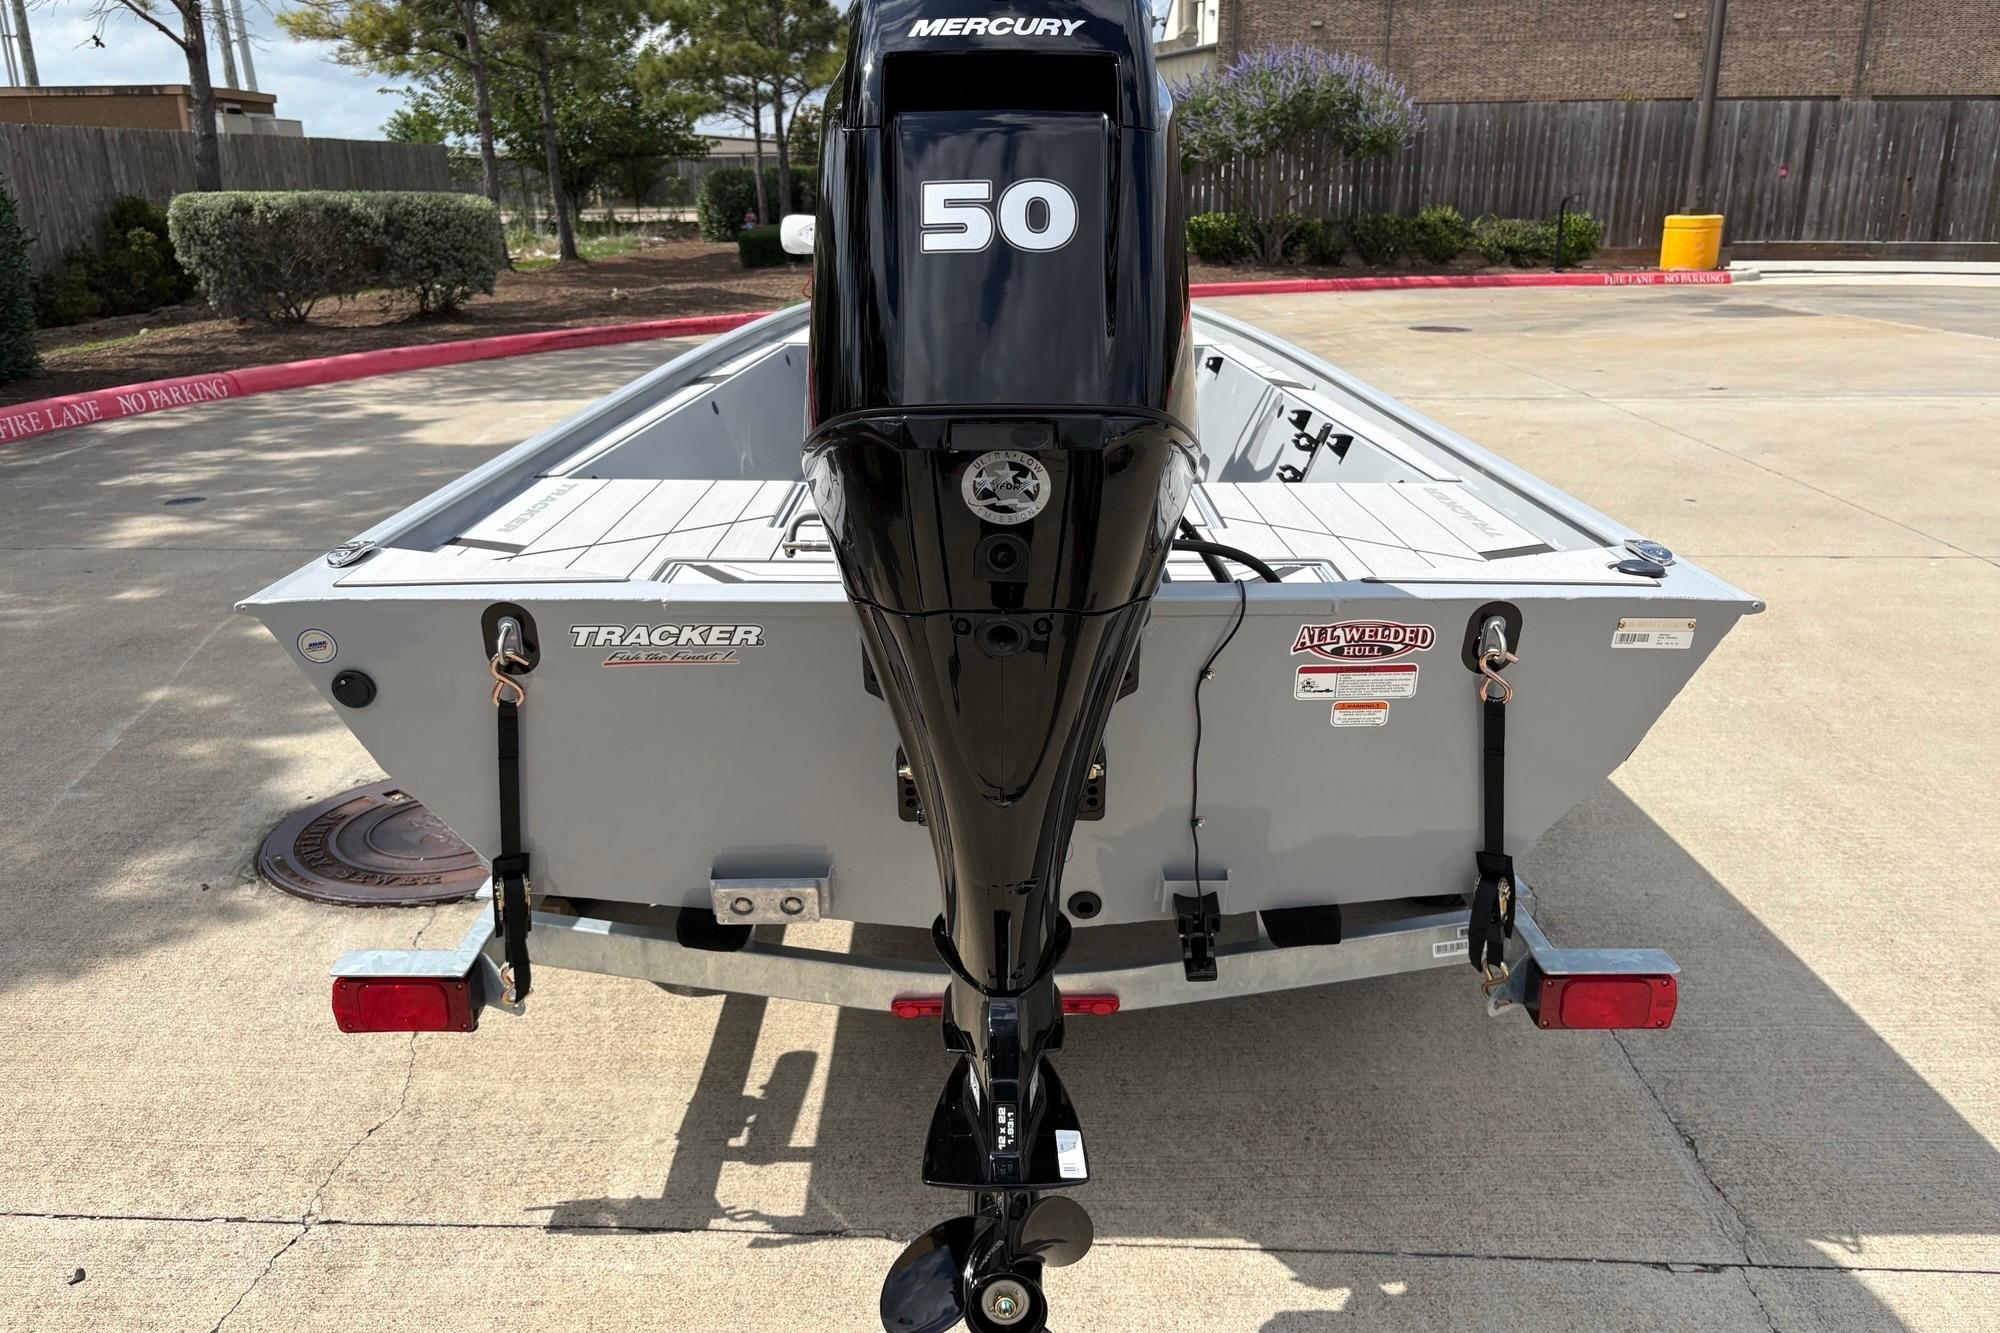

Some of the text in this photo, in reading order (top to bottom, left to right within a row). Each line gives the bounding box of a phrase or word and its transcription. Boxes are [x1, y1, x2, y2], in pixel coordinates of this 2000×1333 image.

[908, 17, 1086, 38] MERCURY
[920, 178, 1080, 254] 50
[1604, 271, 1725, 285] FIRE LANE NO PARKING
[0, 378, 229, 439] FIRE LANE NO PARKING
[973, 451, 1044, 474] ULTRA LOW
[496, 483, 579, 533] TRACKER
[570, 624, 758, 647] TRACKER
[1294, 624, 1434, 651] ALL WELDED
[607, 650, 642, 662] Fish
[645, 650, 668, 662] the
[1342, 646, 1382, 656] HULL
[997, 1106, 1006, 1124] 22
[997, 1135, 1006, 1150] 12
